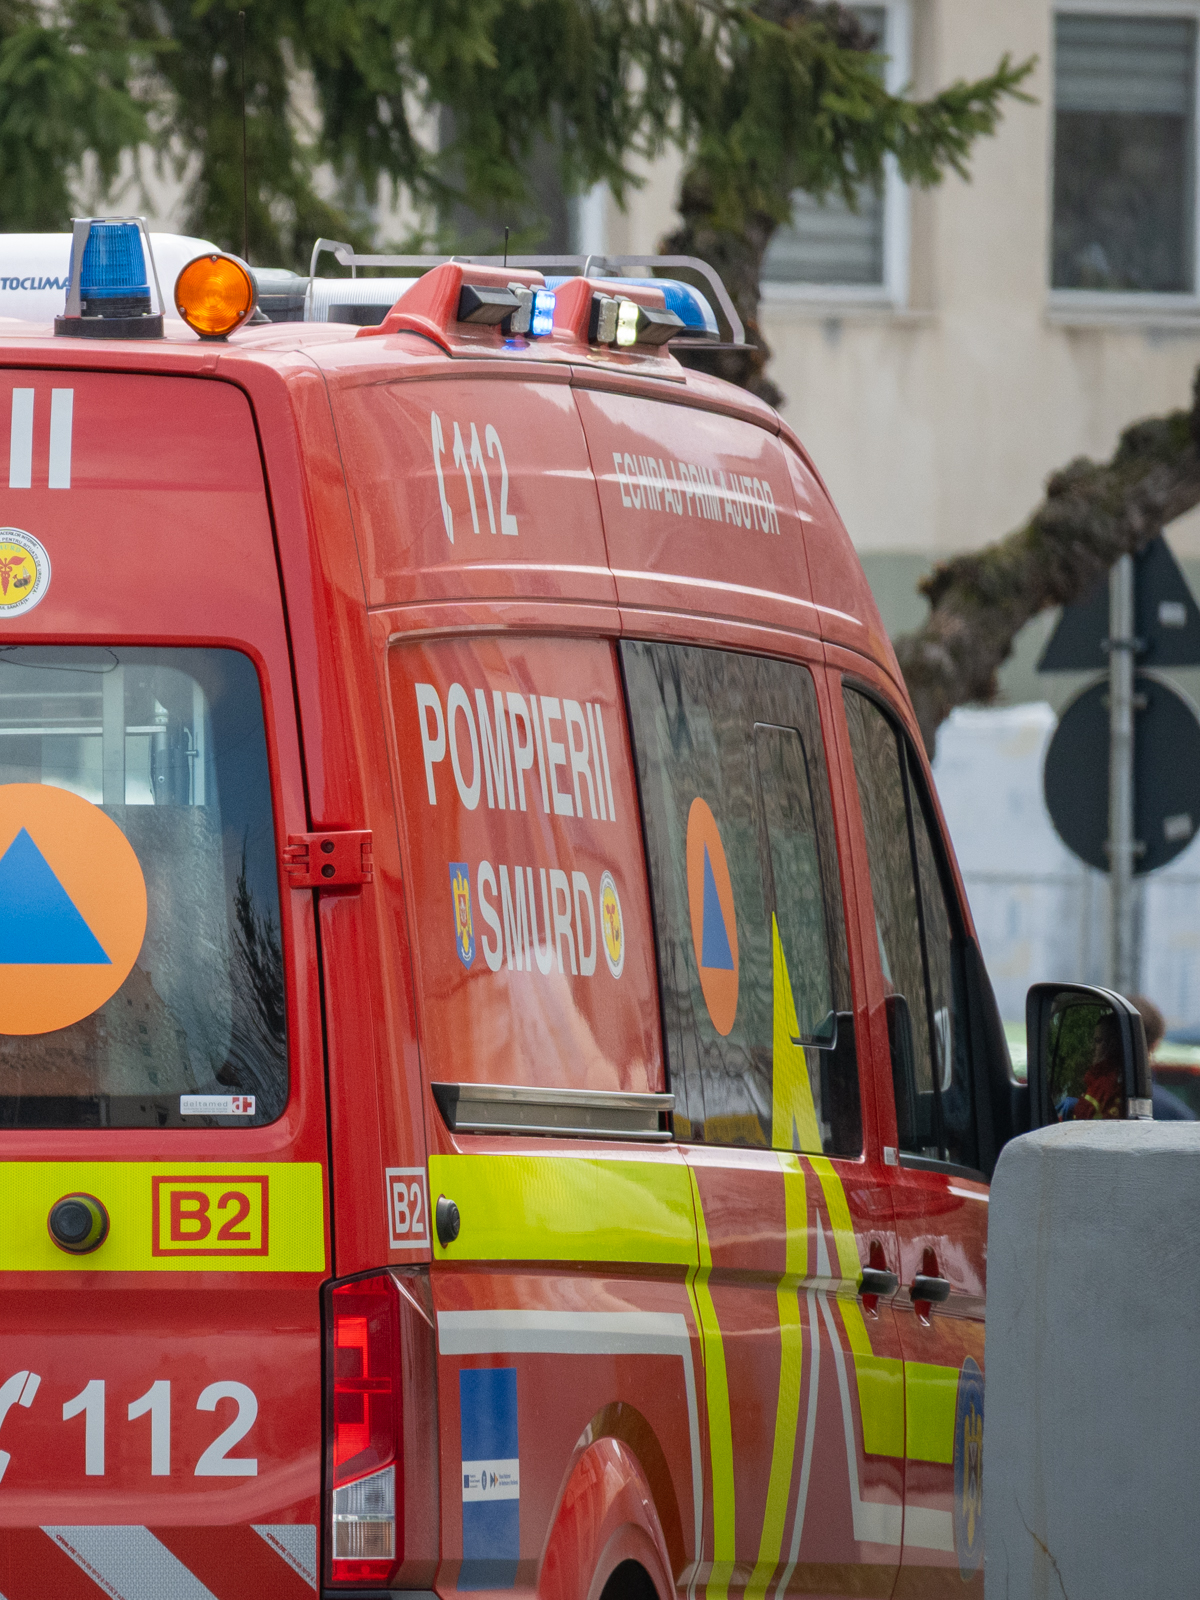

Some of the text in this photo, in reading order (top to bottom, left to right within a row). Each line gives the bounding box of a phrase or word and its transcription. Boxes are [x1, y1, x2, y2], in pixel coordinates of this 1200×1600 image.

[453, 421, 519, 536] 112
[612, 452, 781, 535] ECHIPAJ PRIM AJUTOR
[414, 682, 617, 822] POMPIERII
[477, 860, 597, 977] SMURD
[170, 1190, 251, 1242] B2
[392, 1182, 424, 1234] B2
[62, 1379, 259, 1476] 112
